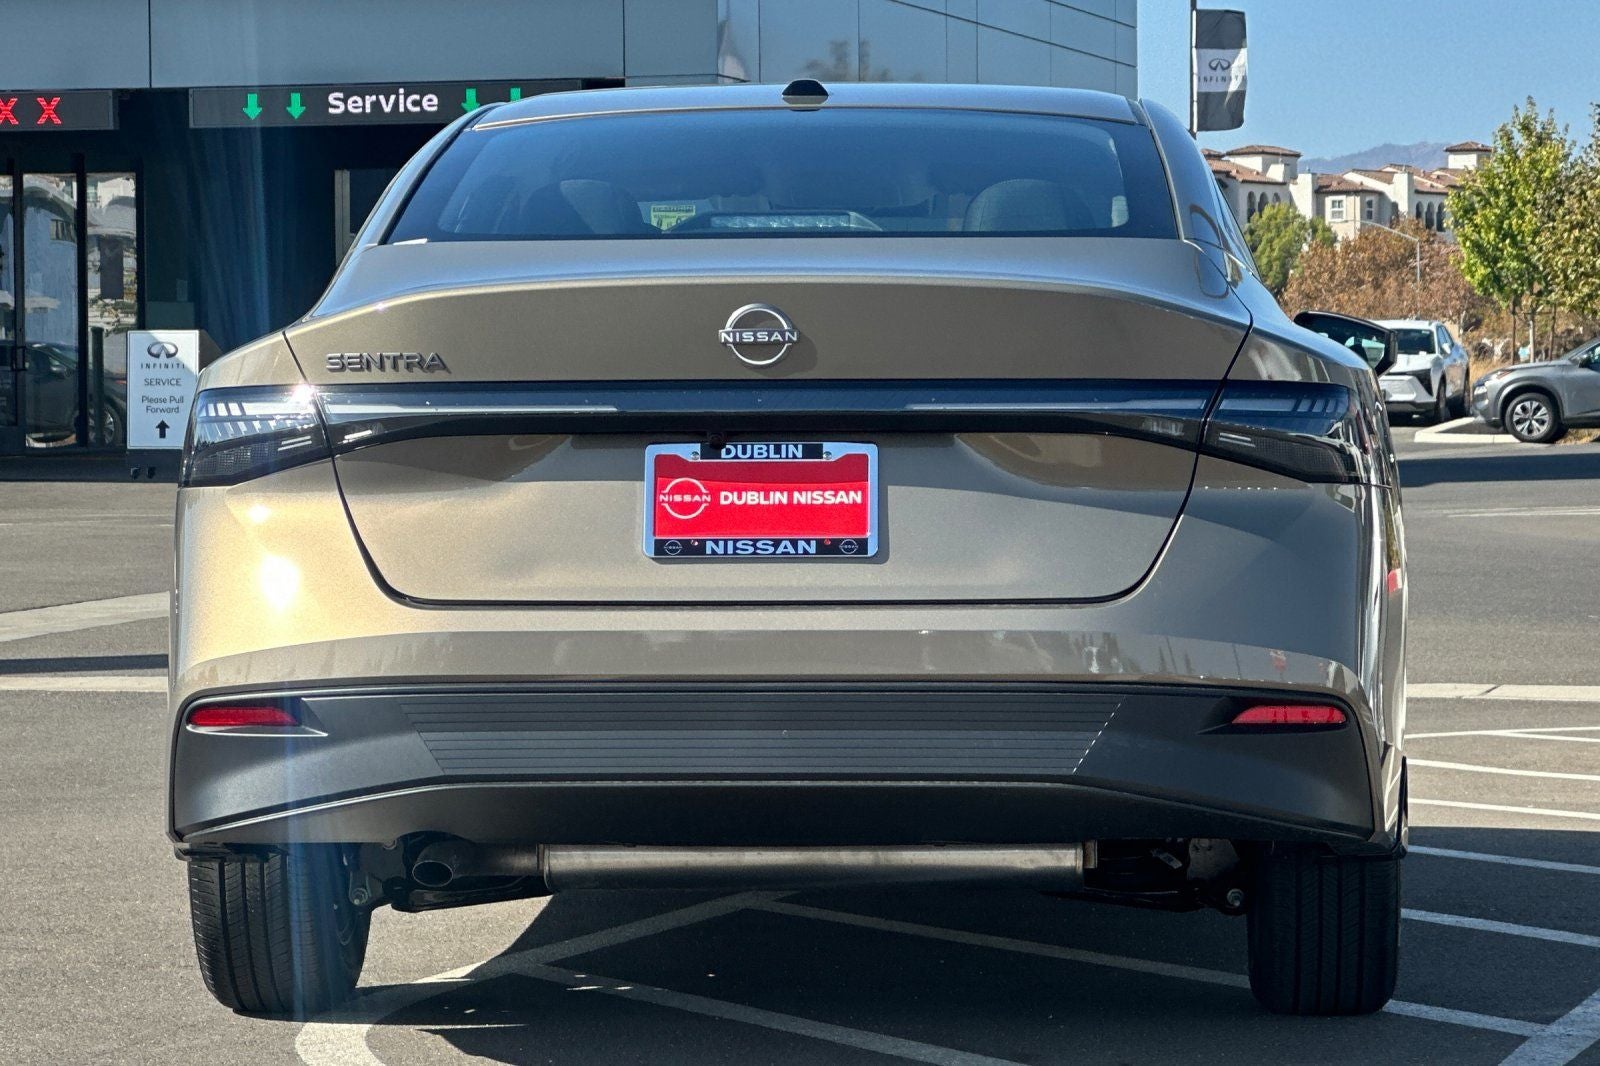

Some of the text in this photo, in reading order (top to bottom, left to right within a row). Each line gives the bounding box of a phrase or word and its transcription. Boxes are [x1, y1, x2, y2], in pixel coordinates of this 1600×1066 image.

[328, 88, 439, 114] Service
[721, 331, 798, 342] NISSAN
[325, 352, 450, 373] SENTRA
[144, 378, 182, 387] SERVICE
[141, 395, 184, 404] Please Pull
[145, 405, 180, 414] Forward
[720, 443, 803, 459] DUBLIN
[659, 494, 711, 503] NISSAN
[719, 490, 862, 505] DUBLIN NISSAN
[705, 539, 817, 555] NISSAN
